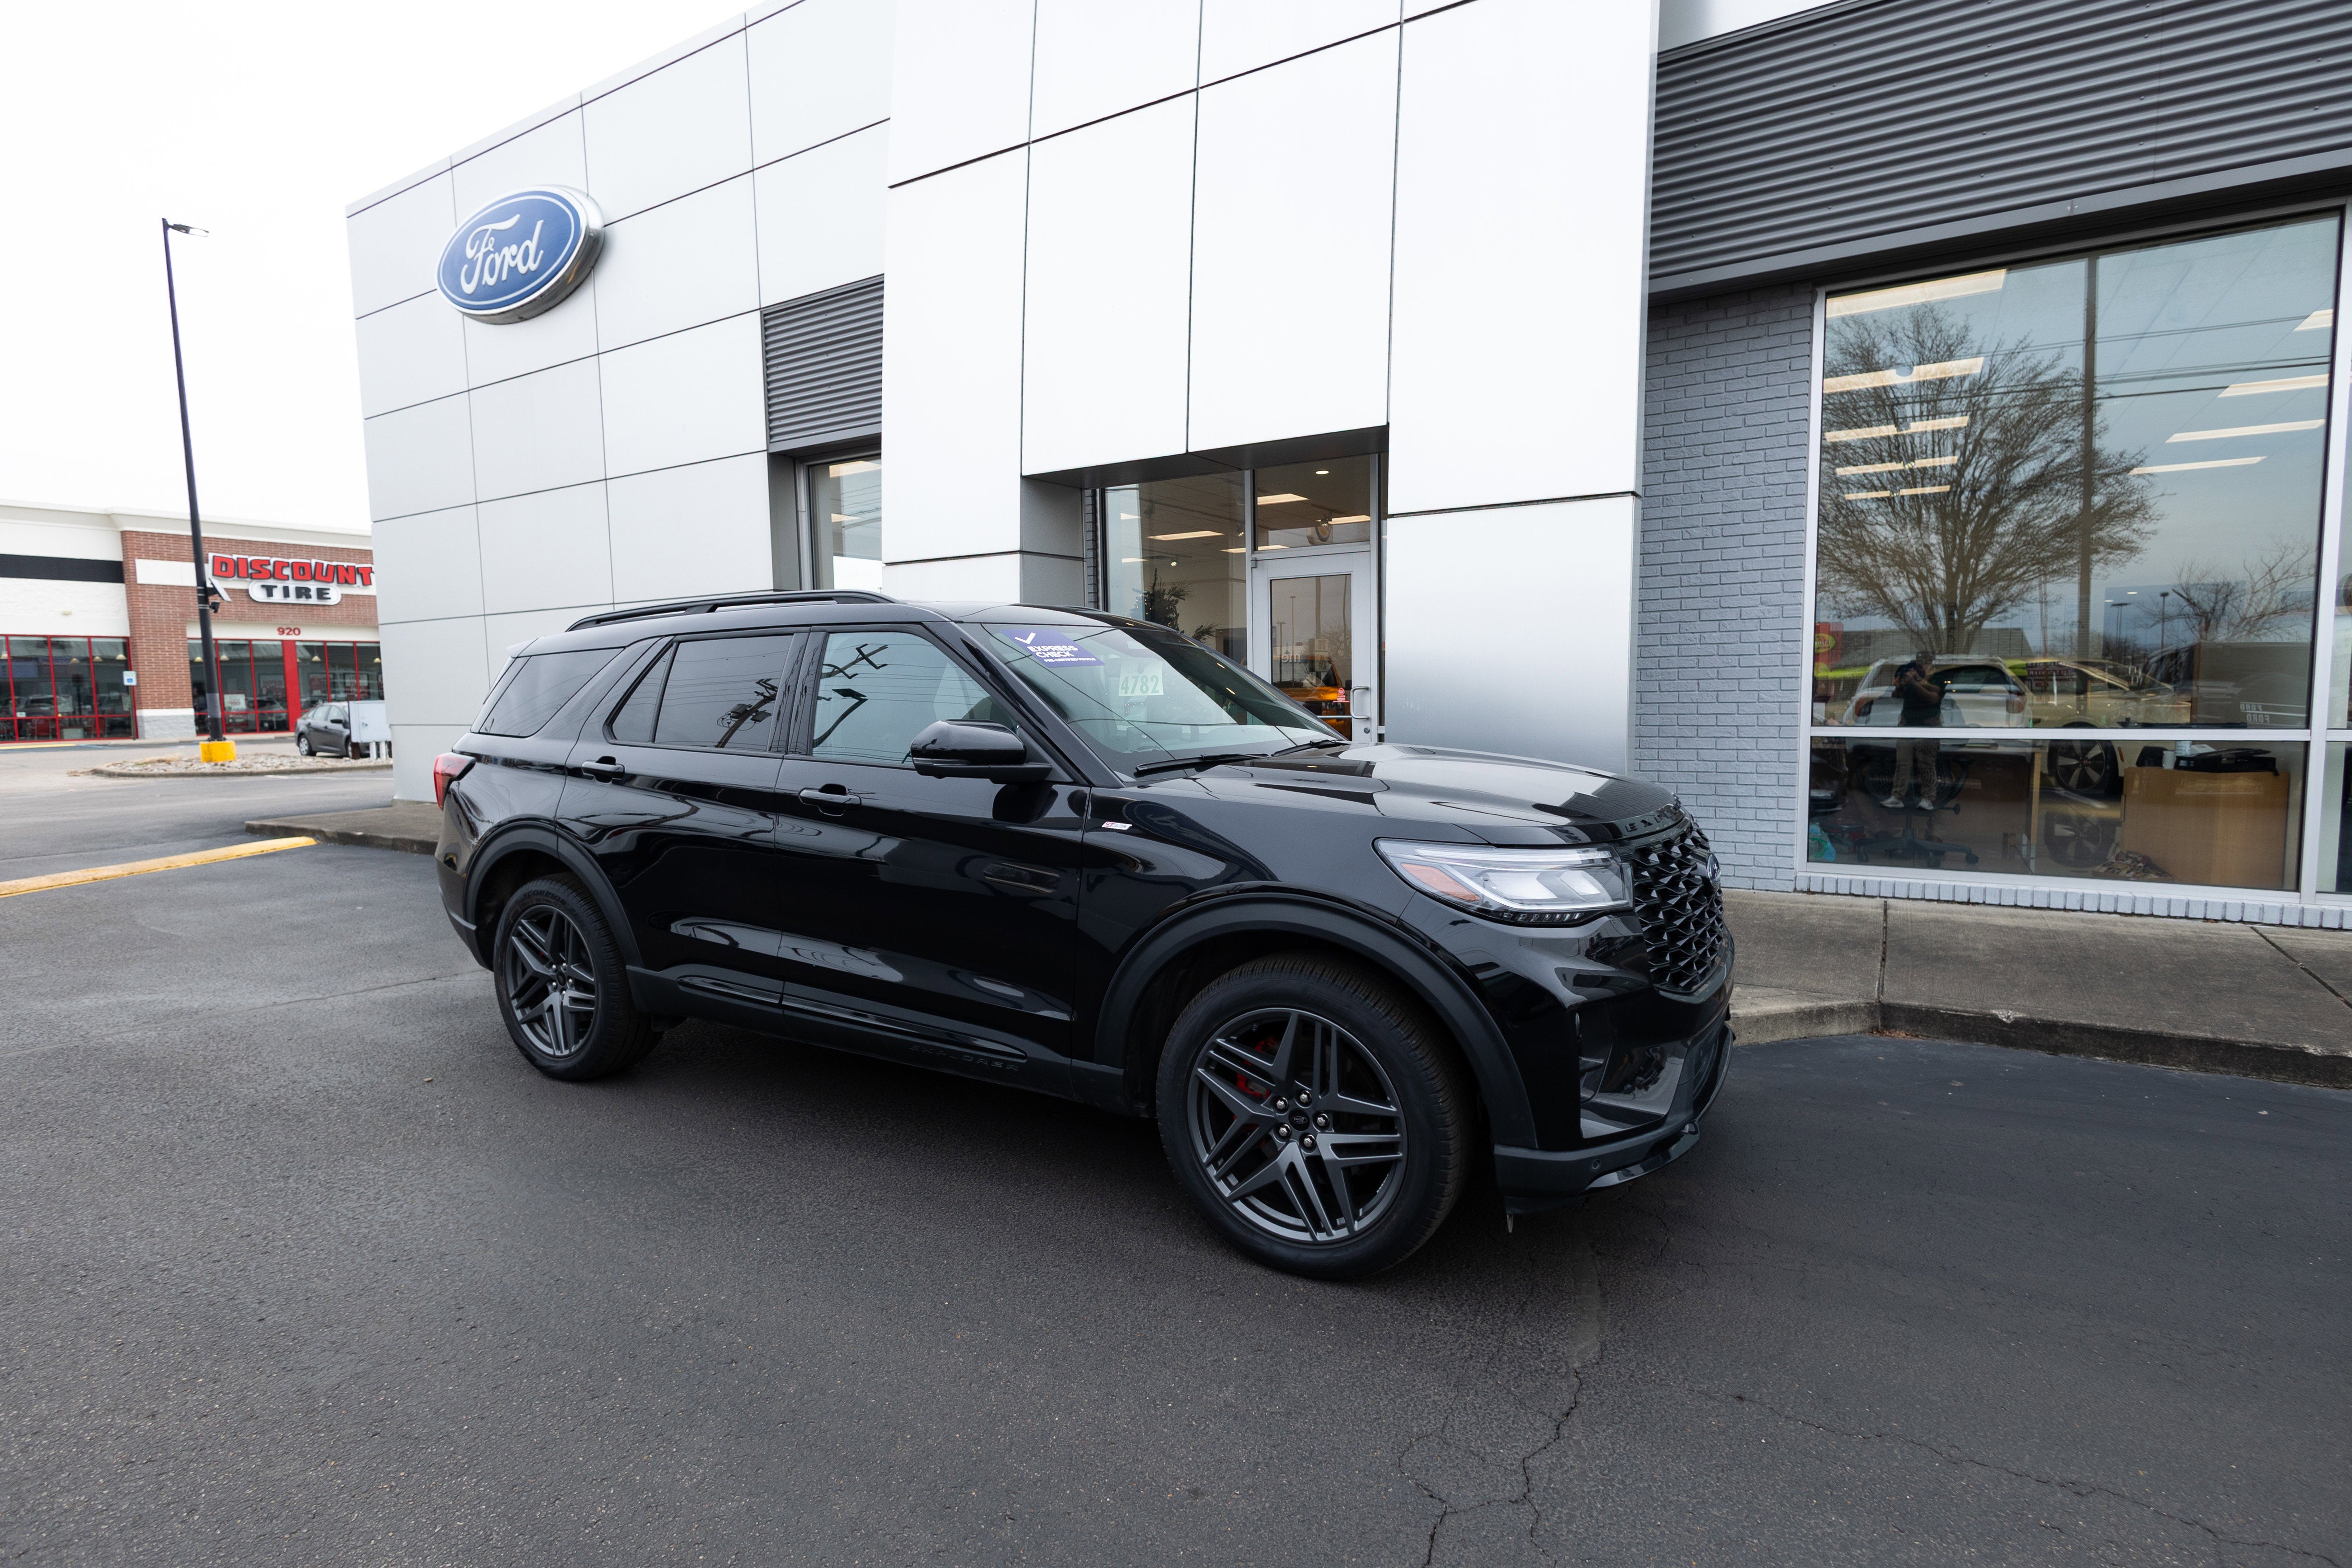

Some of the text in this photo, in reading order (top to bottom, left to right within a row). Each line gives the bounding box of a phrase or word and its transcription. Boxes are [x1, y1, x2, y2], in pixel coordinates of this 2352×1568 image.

[460, 214, 544, 295] Ford
[212, 555, 374, 586] DISCOUNT
[261, 585, 331, 600] TIRE
[277, 627, 301, 636] 920
[1120, 675, 1159, 694] 4782
[1625, 792, 1683, 832] EXPL
[523, 889, 566, 905] SCORPION
